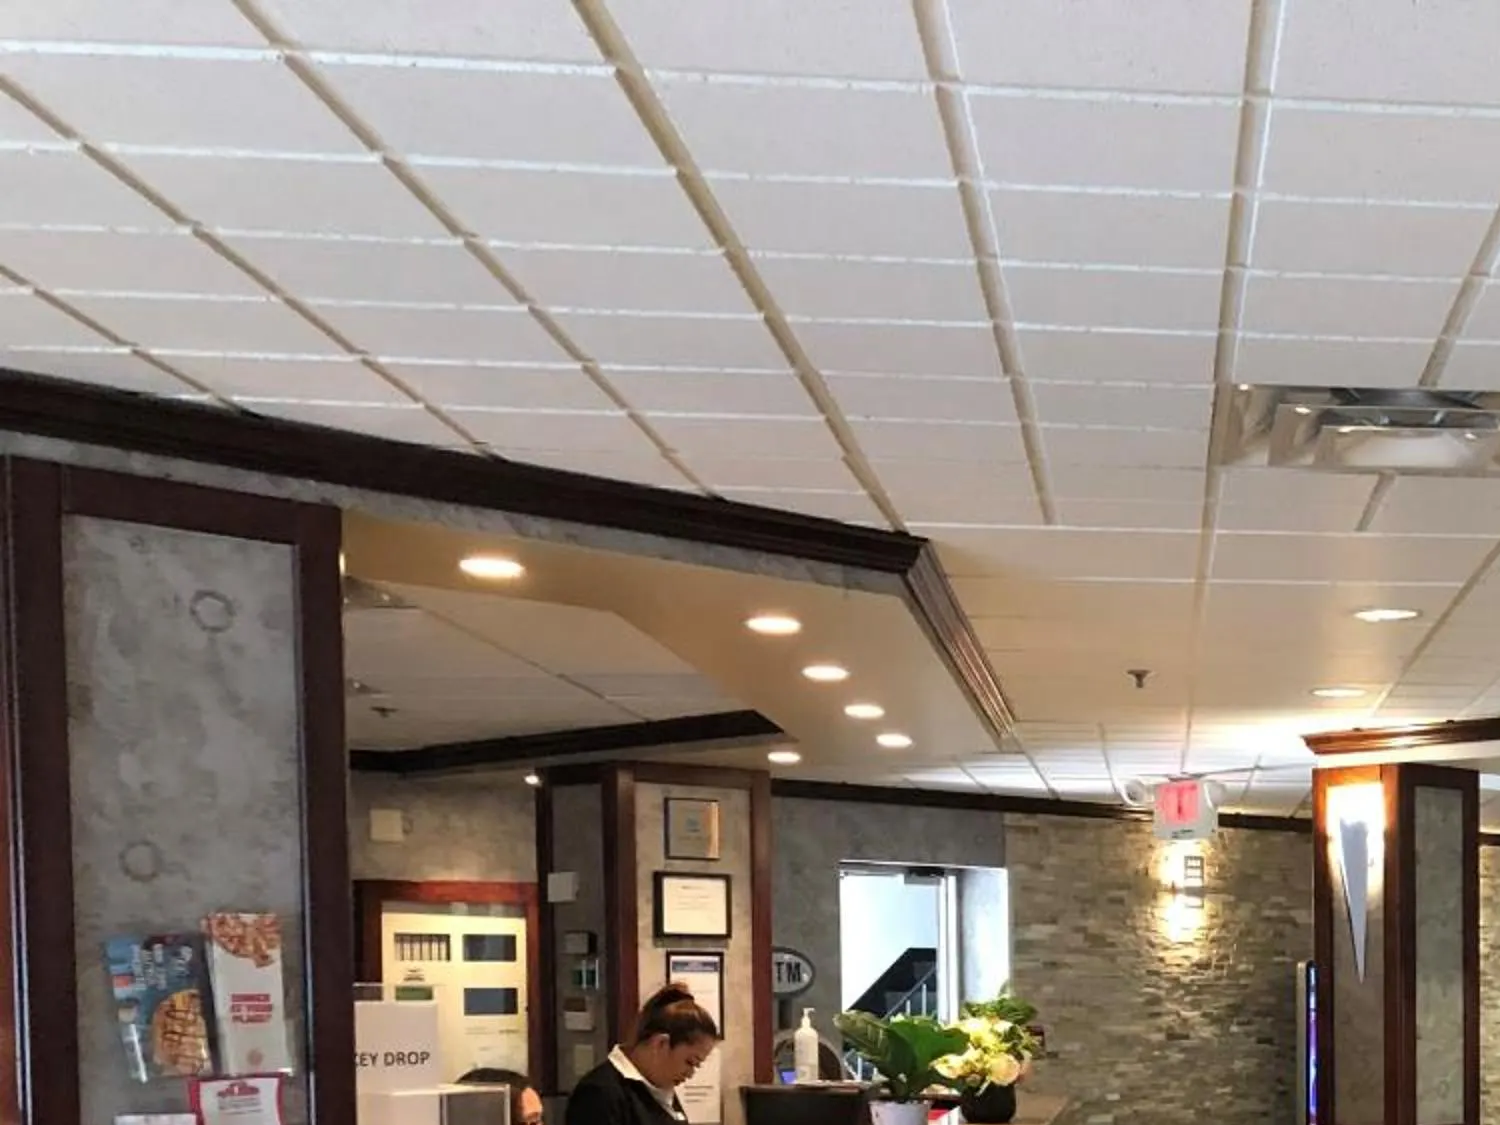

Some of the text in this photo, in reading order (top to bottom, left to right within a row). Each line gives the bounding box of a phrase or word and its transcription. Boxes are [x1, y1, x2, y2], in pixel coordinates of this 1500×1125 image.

[773, 961, 801, 983] TM
[355, 1050, 431, 1067] EY DROP
